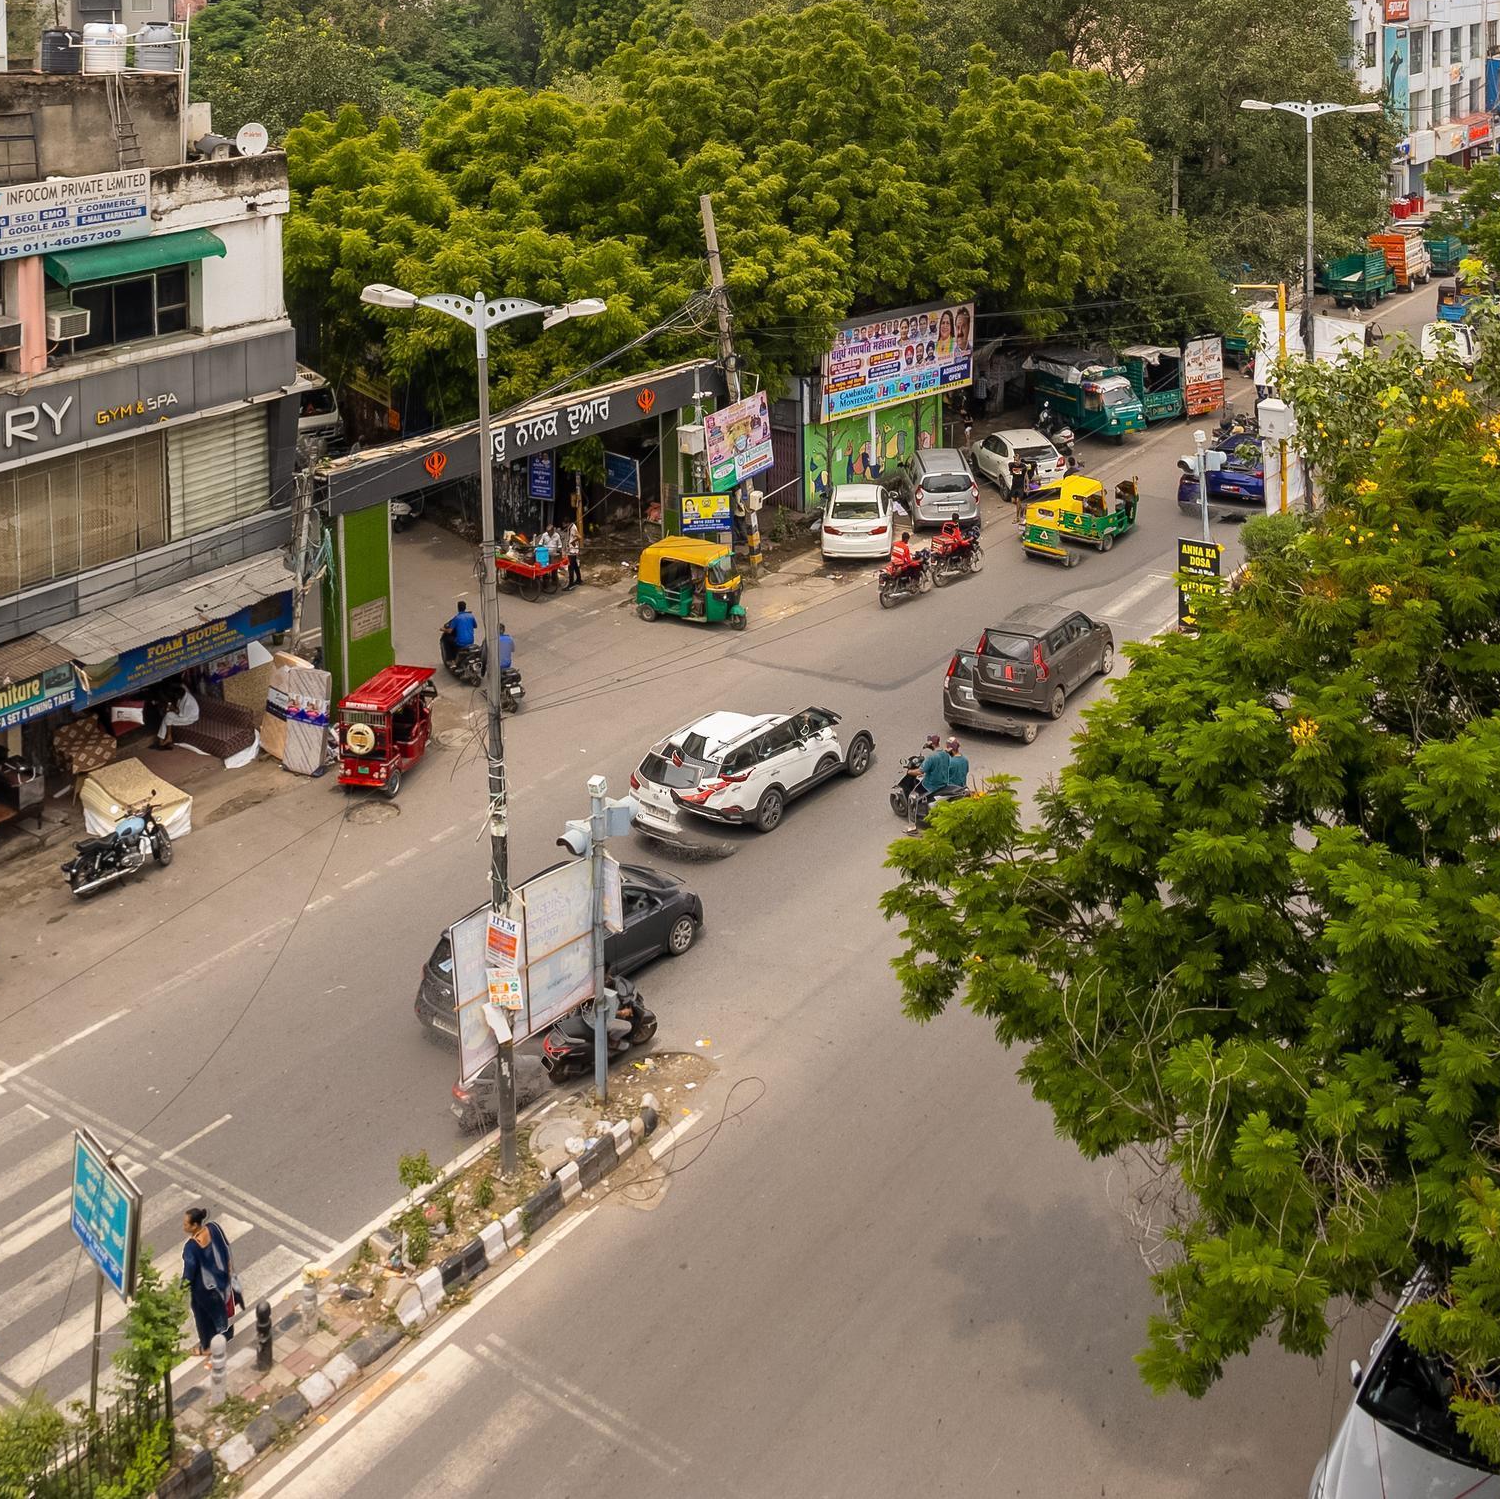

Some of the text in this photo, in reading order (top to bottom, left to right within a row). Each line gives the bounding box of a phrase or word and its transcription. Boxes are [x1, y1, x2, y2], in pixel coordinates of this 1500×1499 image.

[7, 186, 57, 206] INFOCOM
[61, 179, 103, 198] PRIVATE
[107, 173, 146, 191] LIMITED
[101, 192, 117, 200] Your
[78, 199, 137, 213] E-COMMERCE
[15, 213, 35, 223] SEO
[42, 209, 64, 220] SMO
[82, 208, 142, 224] E-MAIL MARKETING
[8, 219, 70, 236] GOOGLE ADS
[23, 229, 122, 252] 011-46057309
[943, 363, 968, 375] ADMISSION
[948, 372, 962, 381] OPEN
[96, 391, 179, 425] GYM & SPA
[515, 412, 558, 447] ਨਾਨਕ
[567, 396, 610, 435] ਦੁਆਰ
[1181, 544, 1216, 559] ANNA KA
[1190, 556, 1211, 568] DOSA
[147, 620, 227, 659] FOAM HOUSE
[7, 712, 21, 725] SET
[22, 710, 28, 719] &
[29, 701, 53, 717] DINING
[54, 690, 76, 708] TABLE
[492, 915, 516, 933] IITM
